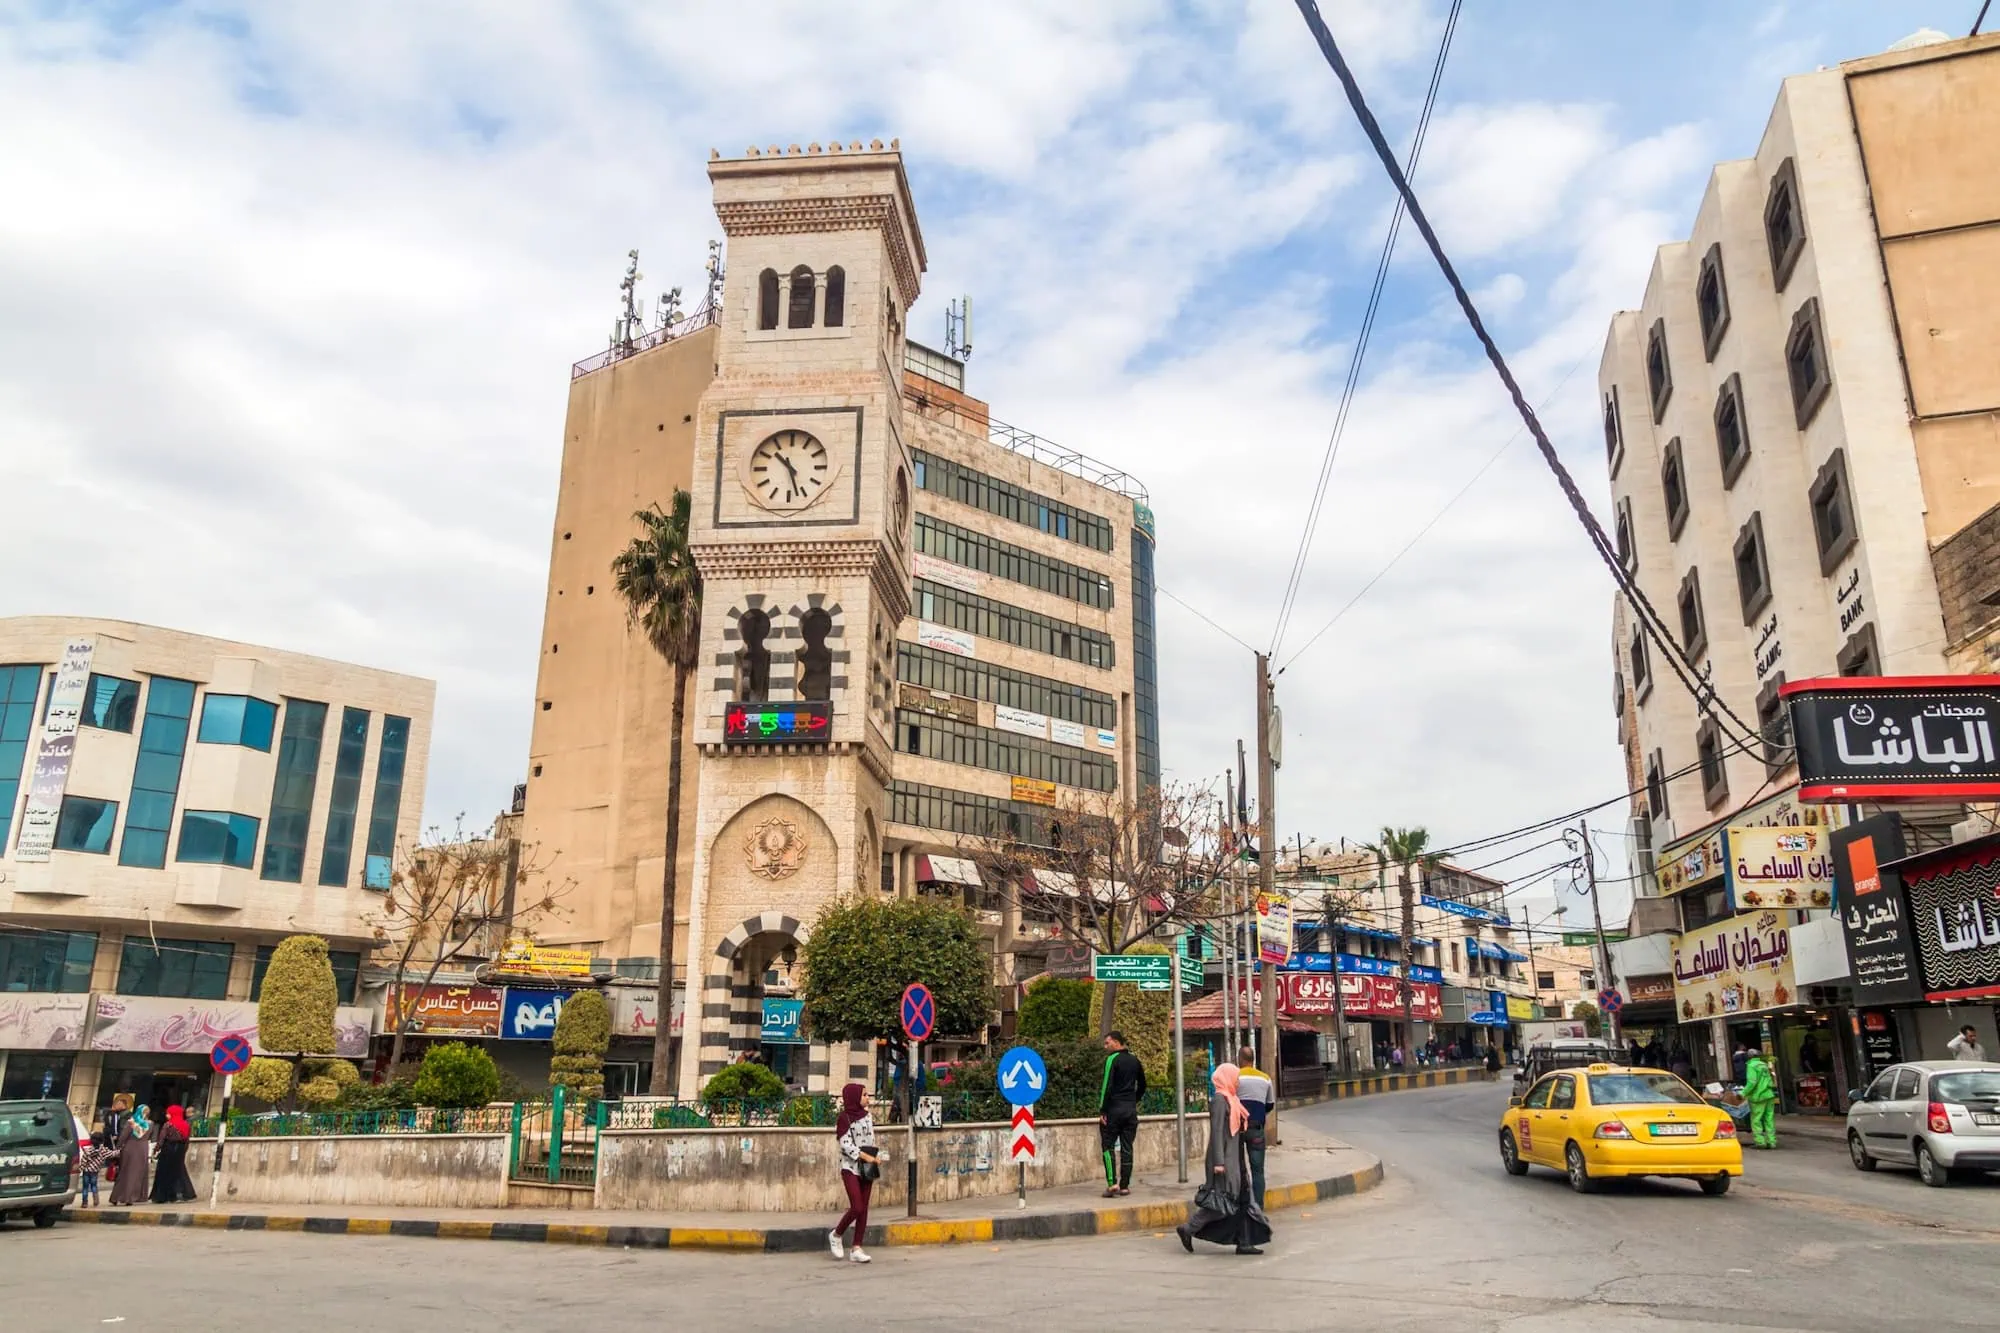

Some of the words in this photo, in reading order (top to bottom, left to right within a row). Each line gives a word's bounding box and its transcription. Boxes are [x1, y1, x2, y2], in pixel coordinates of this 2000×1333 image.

[1840, 594, 1864, 632] BANK
[1756, 640, 1782, 681] ISLAMIC
[1923, 703, 1986, 720] معجنات
[1833, 715, 1996, 774] الباشا
[1738, 856, 1804, 880] الساعة
[1855, 877, 1879, 891] orange
[1756, 911, 1777, 934] مطاعم
[1847, 897, 1899, 934] المحترف
[1935, 898, 2000, 952] باشا
[1105, 958, 1141, 967] الشهيد
[1674, 932, 1731, 982] الساعة
[1732, 926, 1788, 970] ميدان
[416, 994, 458, 1013] عباس
[461, 997, 499, 1015] حسن
